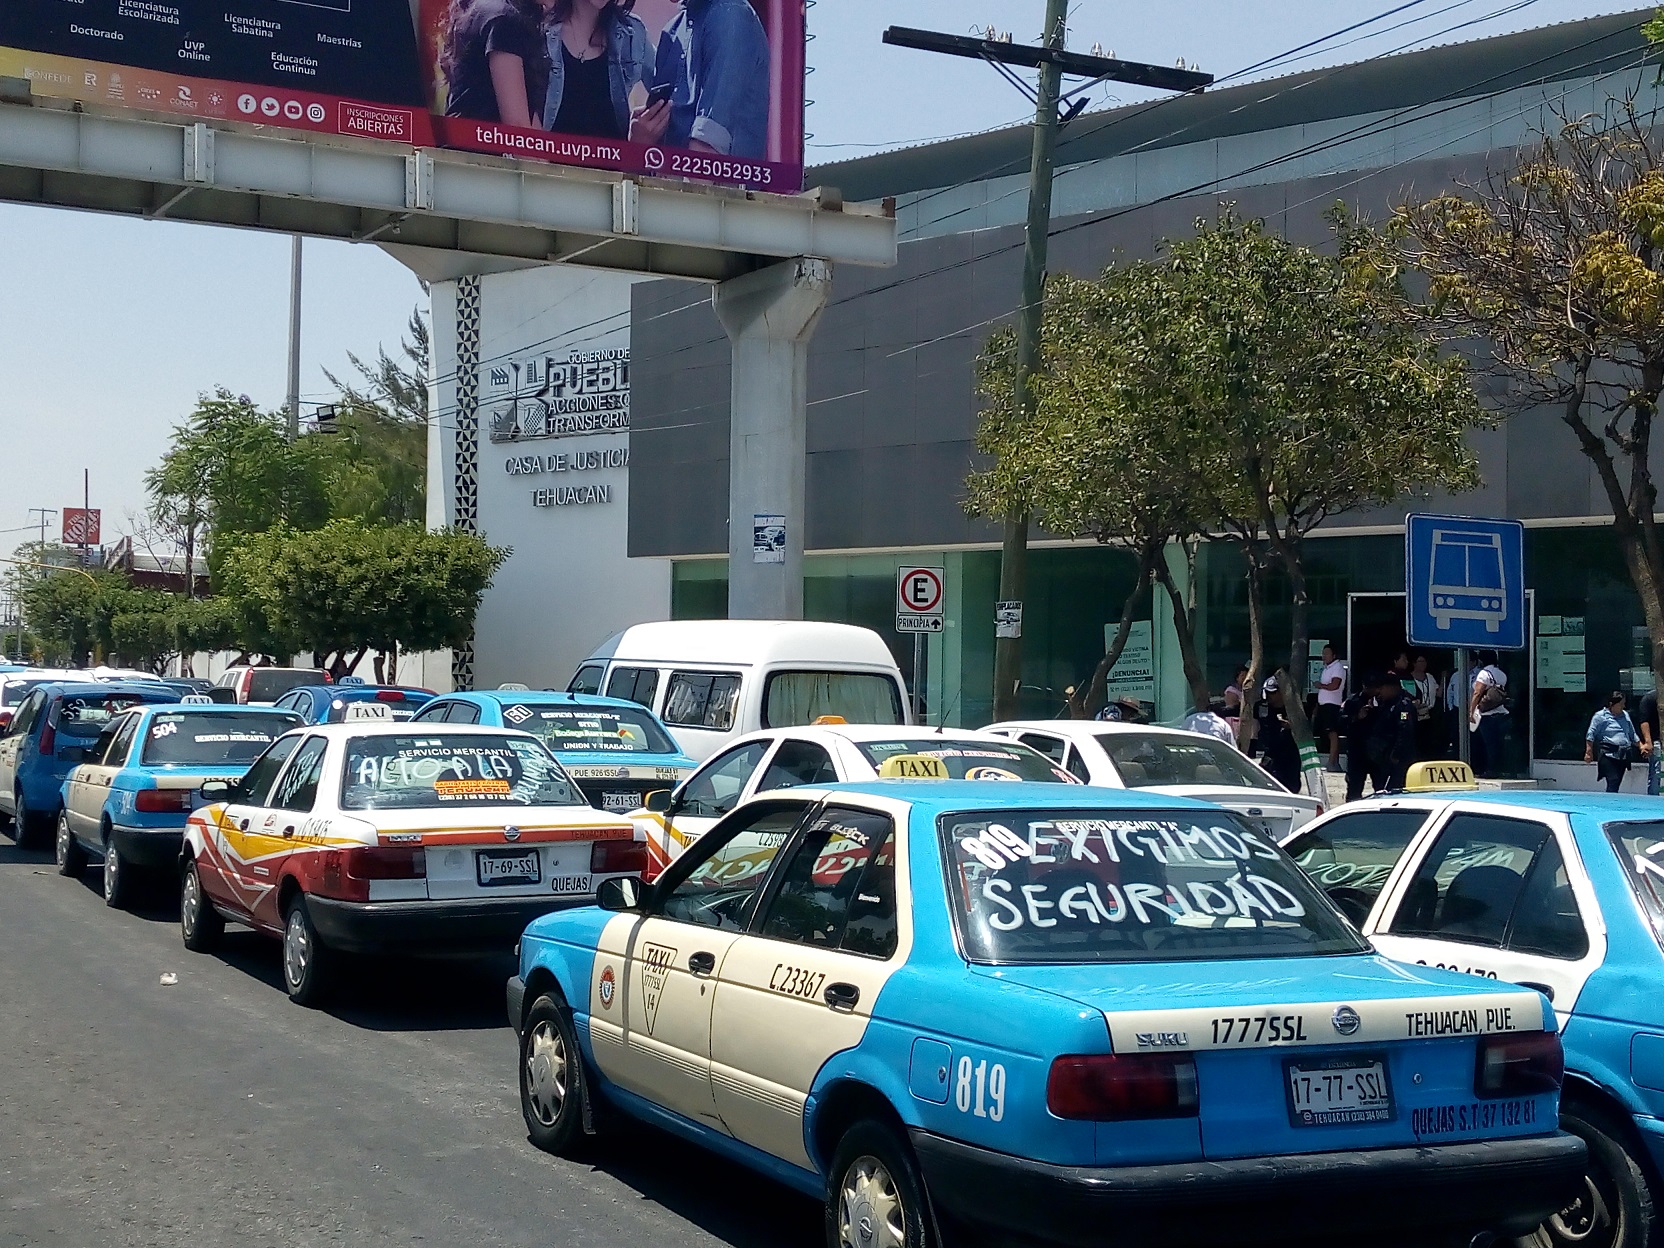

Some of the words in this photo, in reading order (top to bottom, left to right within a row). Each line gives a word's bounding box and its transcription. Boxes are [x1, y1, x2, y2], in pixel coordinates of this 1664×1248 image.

[118, 6, 180, 25] Escolarizada
[119, 0, 179, 15] Licenciatura
[224, 13, 282, 31] Licenciatura
[232, 23, 274, 38] Sabatina
[70, 24, 124, 41] Doctorado
[184, 40, 205, 52] UVP
[178, 49, 211, 62] Online
[271, 51, 319, 68] Educación
[273, 61, 317, 76] Continua
[346, 107, 404, 123] INSCRIPCIONES
[347, 118, 404, 136] ABIERTAS
[476, 126, 621, 161] tehuacan.uvp.mx
[672, 155, 772, 184] 2225052933
[568, 349, 616, 364] GOBIERNO
[548, 394, 619, 413] ACCIONES
[505, 455, 542, 475] CASA
[547, 453, 567, 473] DE
[532, 484, 611, 507] TEHUACAN
[913, 577, 928, 602] E
[899, 617, 930, 630] PRINCIPIA
[346, 677, 362, 685] TAXI
[353, 707, 385, 718] TAXI
[152, 721, 179, 740] 504
[399, 747, 451, 758] SERVICIO
[453, 747, 513, 758] MERCANTIL
[564, 742, 590, 750] UNION
[599, 743, 634, 751] TRABAJO
[356, 755, 440, 785] ALTO
[451, 755, 473, 781] A
[479, 755, 513, 781] LA
[895, 760, 940, 777] TAXI
[1425, 766, 1467, 783] TAXI
[602, 795, 641, 806] 92-61-SSL
[1055, 820, 1104, 832] SERVICIO
[1105, 820, 1162, 832] MERCANTIL
[961, 823, 1033, 869] 819
[483, 859, 537, 874] 17-69-SSL
[982, 875, 1305, 931] SEGURIDAD
[643, 947, 672, 976] TAXI
[769, 963, 826, 999] C.23367
[646, 993, 655, 1011] 14
[1486, 1006, 1516, 1032] PUE.
[1211, 1015, 1307, 1043] 1777SSL
[955, 1055, 1006, 1122] 819
[1292, 1073, 1388, 1104] 17-77-SSL
[1314, 1112, 1350, 1124] TEHUACAN
[1412, 1105, 1455, 1141] QUEJAS
[1481, 1103, 1496, 1129] 37
[1523, 1101, 1536, 1124] 81
